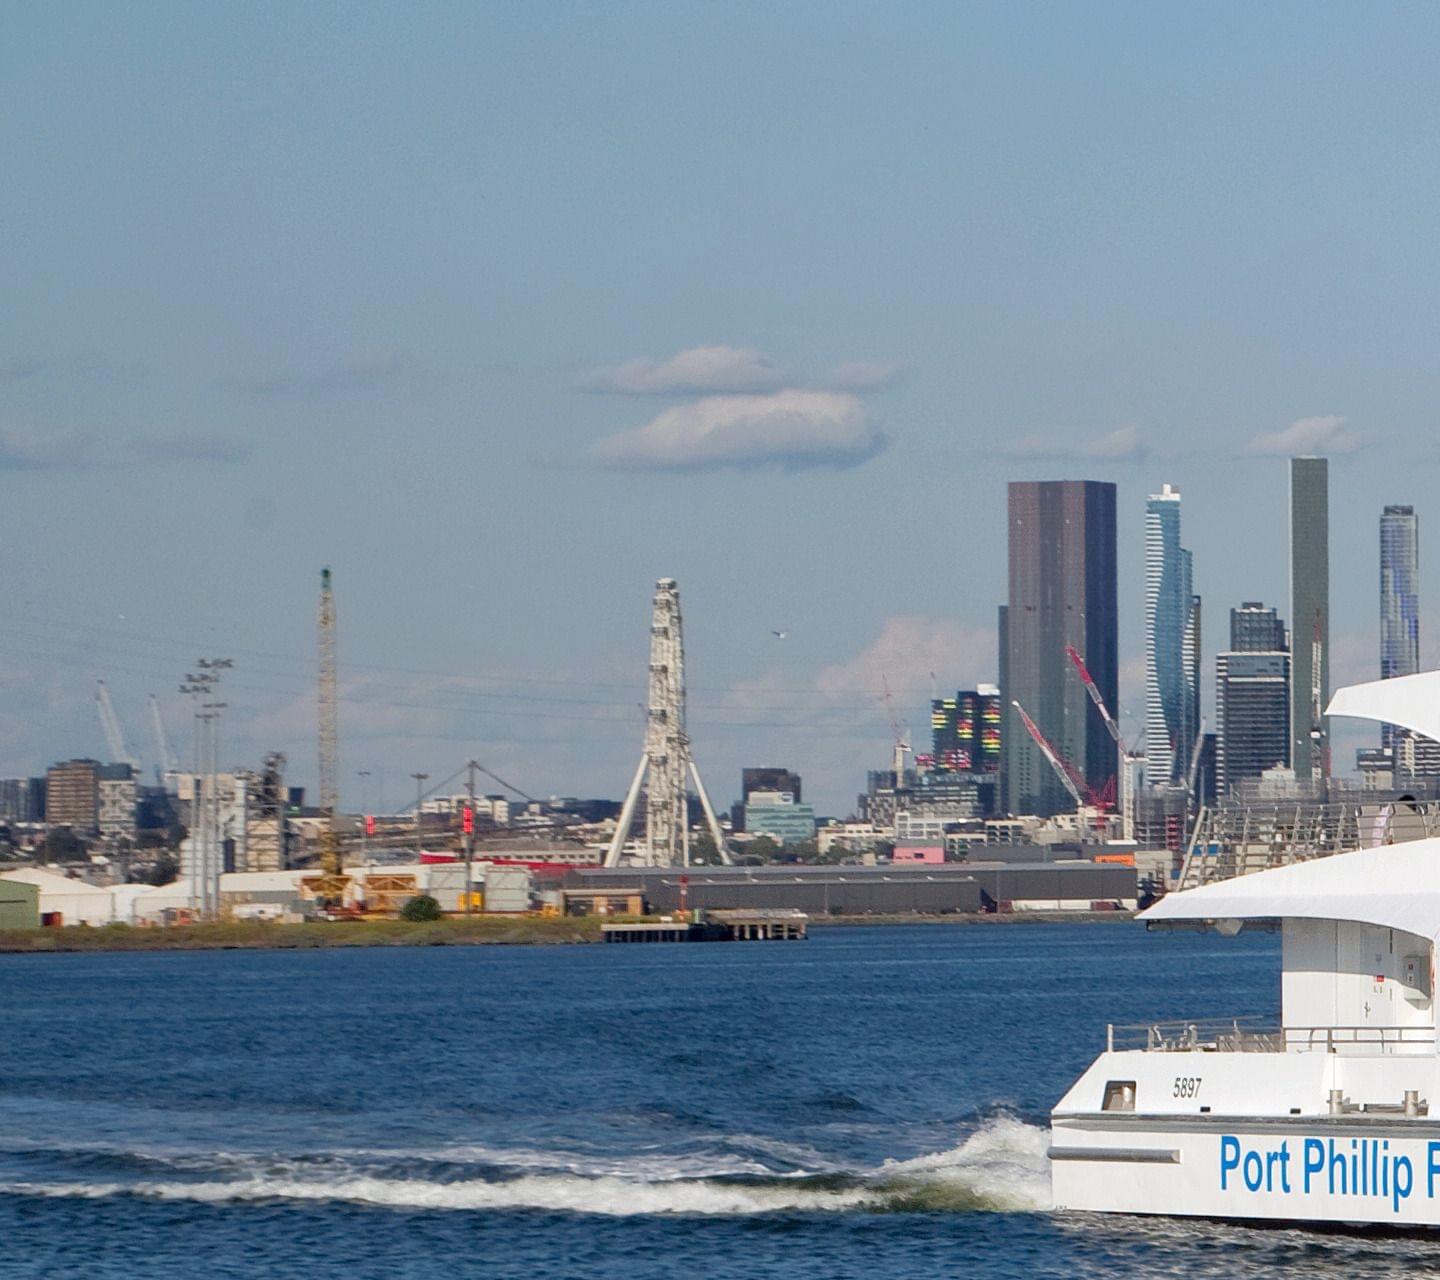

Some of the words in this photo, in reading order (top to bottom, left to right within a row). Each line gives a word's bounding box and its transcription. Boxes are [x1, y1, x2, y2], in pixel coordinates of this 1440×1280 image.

[1172, 1077, 1203, 1099] 5897
[1220, 1135, 1291, 1194] Port
[1304, 1138, 1413, 1213] Phillip
